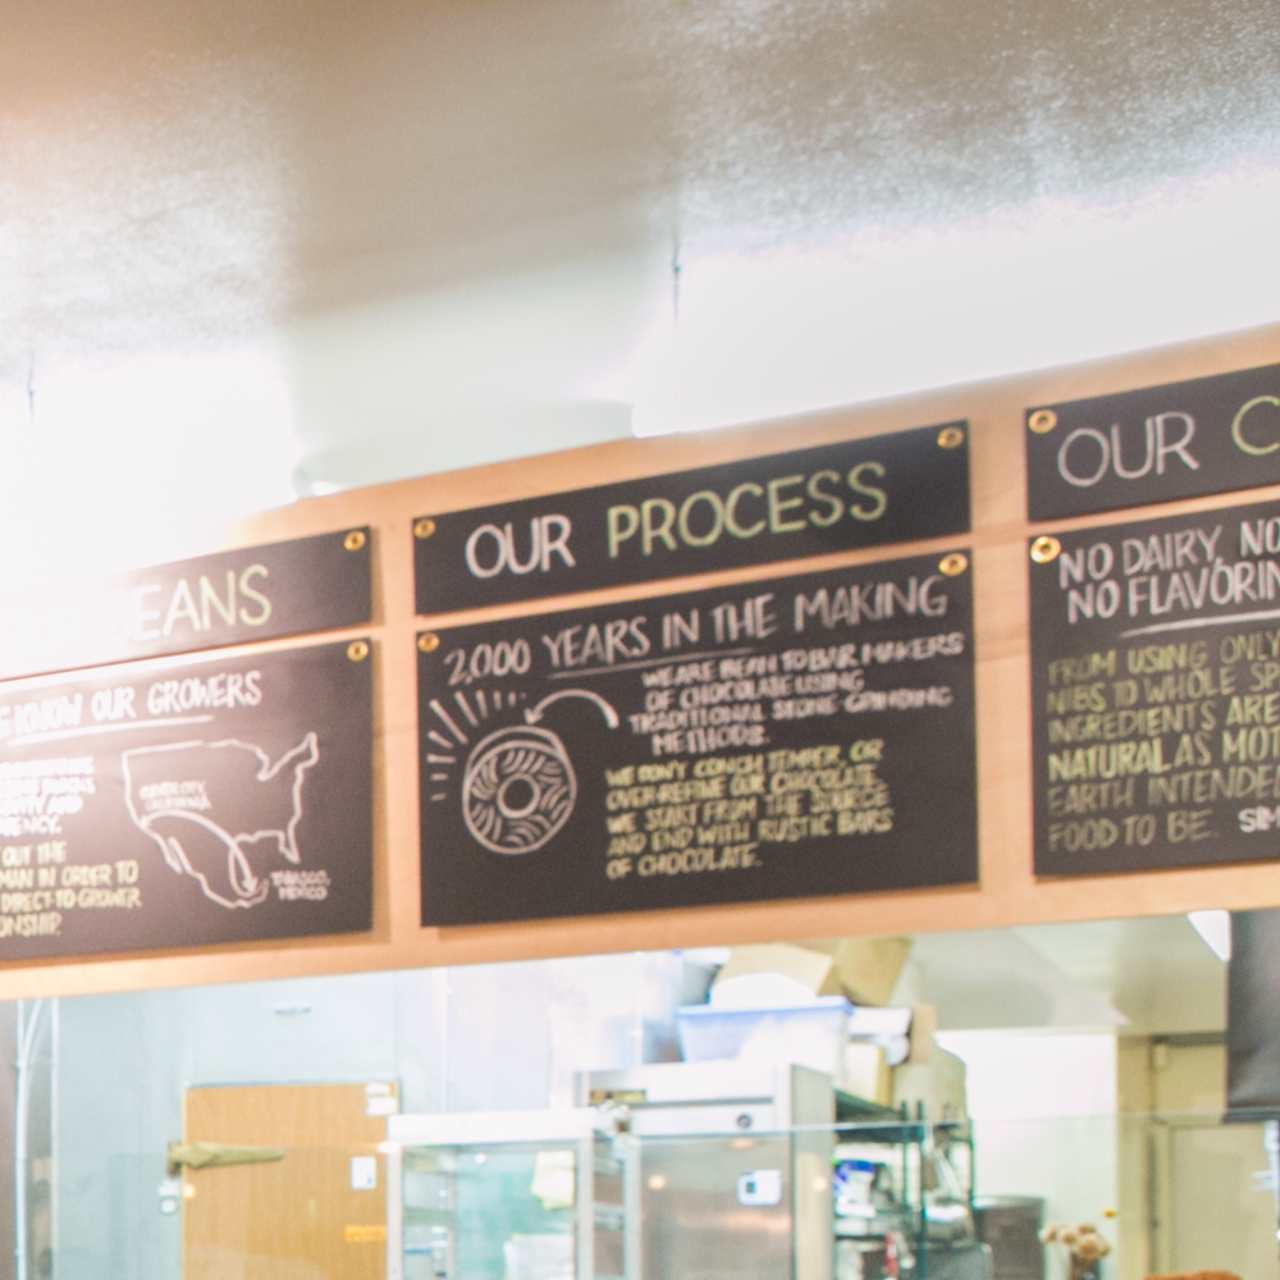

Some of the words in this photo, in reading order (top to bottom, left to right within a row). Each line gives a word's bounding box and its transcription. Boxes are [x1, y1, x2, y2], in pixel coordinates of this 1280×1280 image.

[1058, 411, 1200, 487] OUR
[465, 515, 576, 579] OUR
[607, 461, 888, 558] PROCESS
[1059, 542, 1113, 589] NO
[130, 563, 273, 641] EANS
[1068, 579, 1120, 624] NO
[445, 638, 530, 686] 2,000
[541, 617, 649, 667] YEARS
[662, 608, 699, 648] IN
[712, 593, 778, 641] THE
[794, 576, 948, 631] MAKING
[641, 667, 673, 688] WE
[677, 660, 716, 684] ARE
[719, 653, 778, 681] BEAN
[782, 649, 808, 673] TO
[809, 644, 858, 670] BAR
[862, 632, 965, 664] MAKERS
[1047, 649, 1117, 686] FROM
[1127, 641, 1208, 674] USING
[14, 693, 83, 735] KNOW
[91, 686, 137, 722] OUR
[147, 670, 263, 715] GROWERS
[630, 702, 765, 733] TRADITIONAL
[772, 695, 837, 721] STONE
[843, 686, 953, 713] GRINDING
[645, 690, 674, 713] OF
[680, 676, 794, 708] CHOCOLATE
[795, 669, 864, 697] USING
[1046, 683, 1107, 716] NIBS
[1112, 678, 1139, 708] TO
[1142, 666, 1238, 704] WHOLE
[1047, 700, 1217, 744] INGREDIENTS
[1225, 692, 1280, 726] ARE
[606, 767, 636, 786] WE
[849, 739, 884, 762] OR
[1047, 736, 1173, 784] NATURAL
[1173, 732, 1213, 768] AS
[606, 813, 636, 833] WE
[644, 804, 699, 829] START
[703, 797, 758, 823] FROM
[764, 792, 804, 816] THE
[810, 782, 890, 813] SOURCE
[730, 774, 765, 796] OUR
[1047, 777, 1137, 817] EARTH
[2, 845, 32, 867] OUT
[36, 840, 67, 864] THE
[609, 832, 646, 856] AND
[652, 827, 694, 851] END
[698, 820, 750, 845] WITH
[758, 814, 831, 842] RUSTIC
[837, 807, 894, 835] BARS
[1047, 817, 1119, 853] FOOD
[1122, 813, 1158, 847] TO
[37, 866, 57, 888] IN
[60, 863, 113, 886] ORDER
[115, 859, 139, 883] TO
[606, 856, 632, 880] OF
